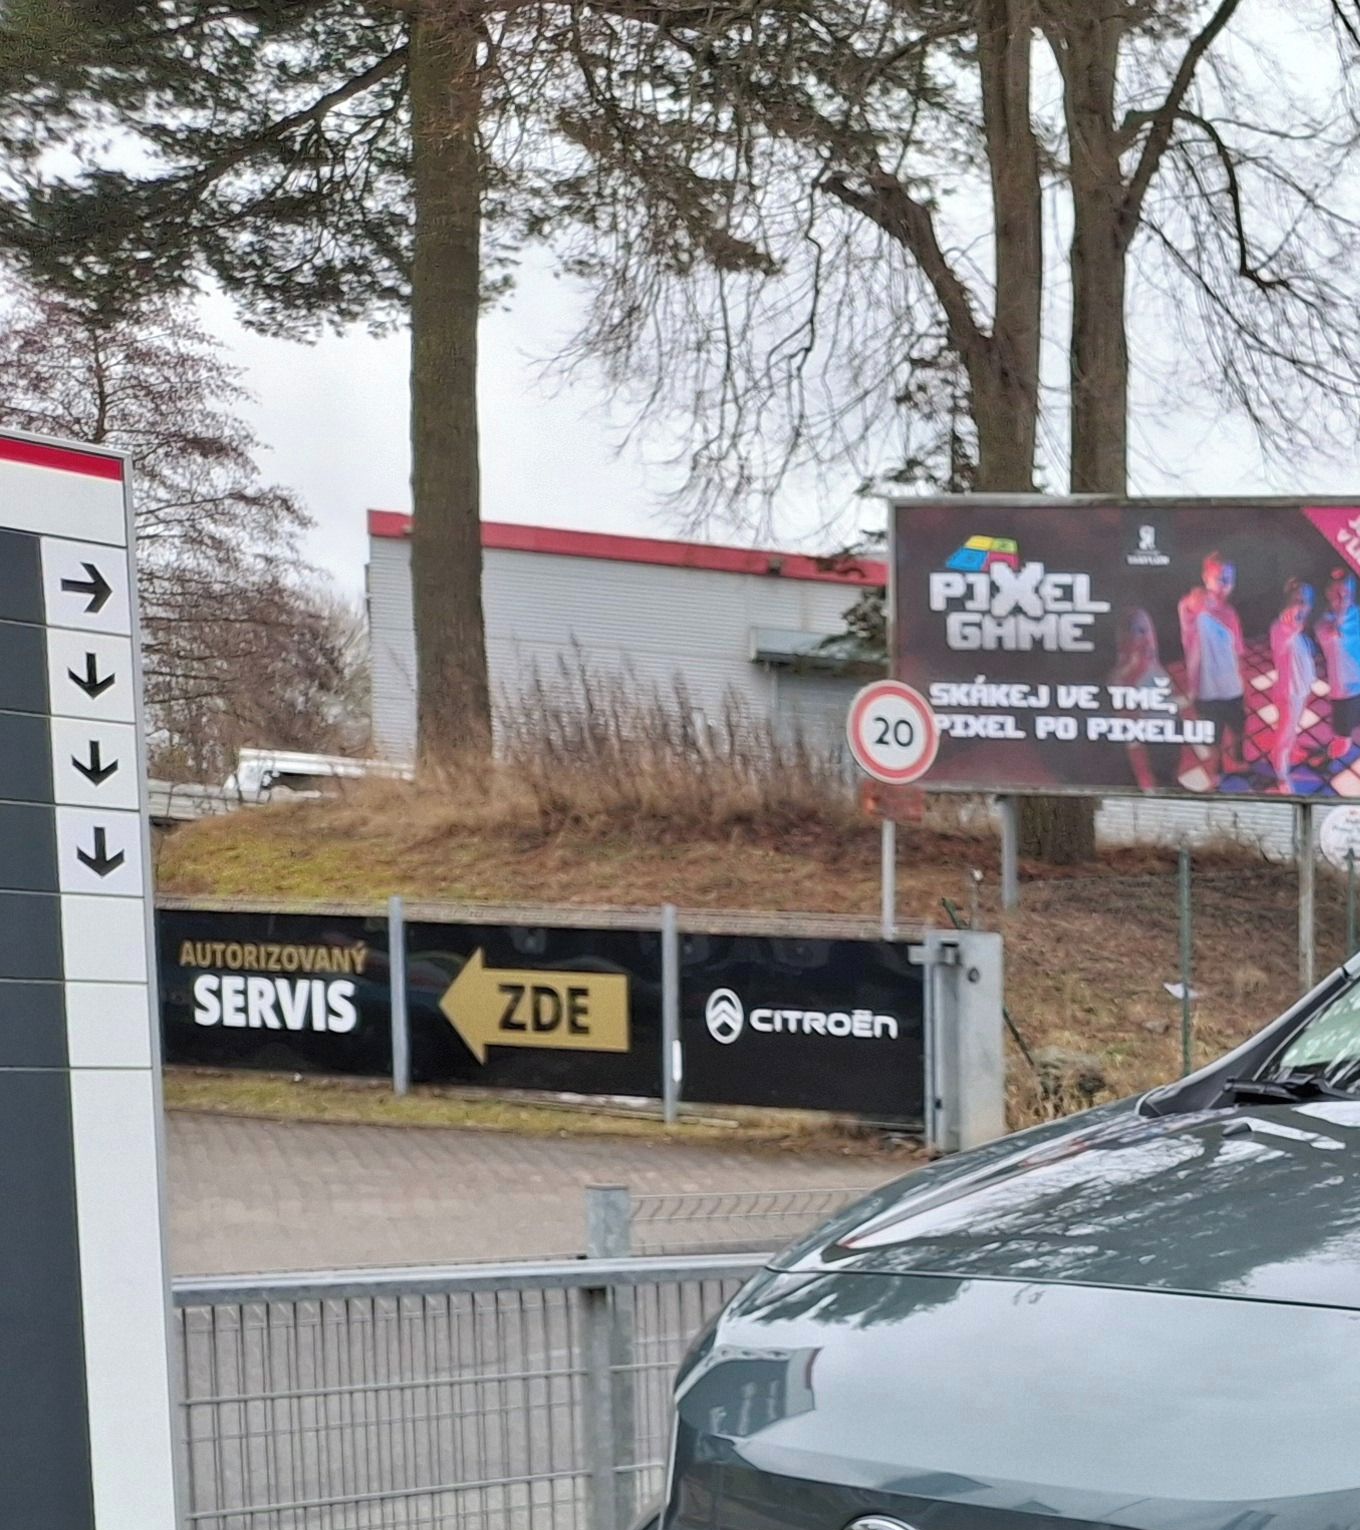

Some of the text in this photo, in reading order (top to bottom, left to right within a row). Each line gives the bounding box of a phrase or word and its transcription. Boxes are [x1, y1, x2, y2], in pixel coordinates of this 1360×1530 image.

[929, 561, 1111, 618] PIXEL
[946, 612, 1096, 651] GAME
[929, 675, 1178, 714] SKÁKEJ VE TMĚ,
[873, 716, 914, 748] 20
[934, 714, 1216, 743] PIXEL PO PIXELU!
[179, 940, 368, 974] AUTORIZOVANÝ
[192, 973, 358, 1034] SERVIS
[497, 982, 592, 1037] ZDE
[749, 1006, 898, 1040] CITROËN
